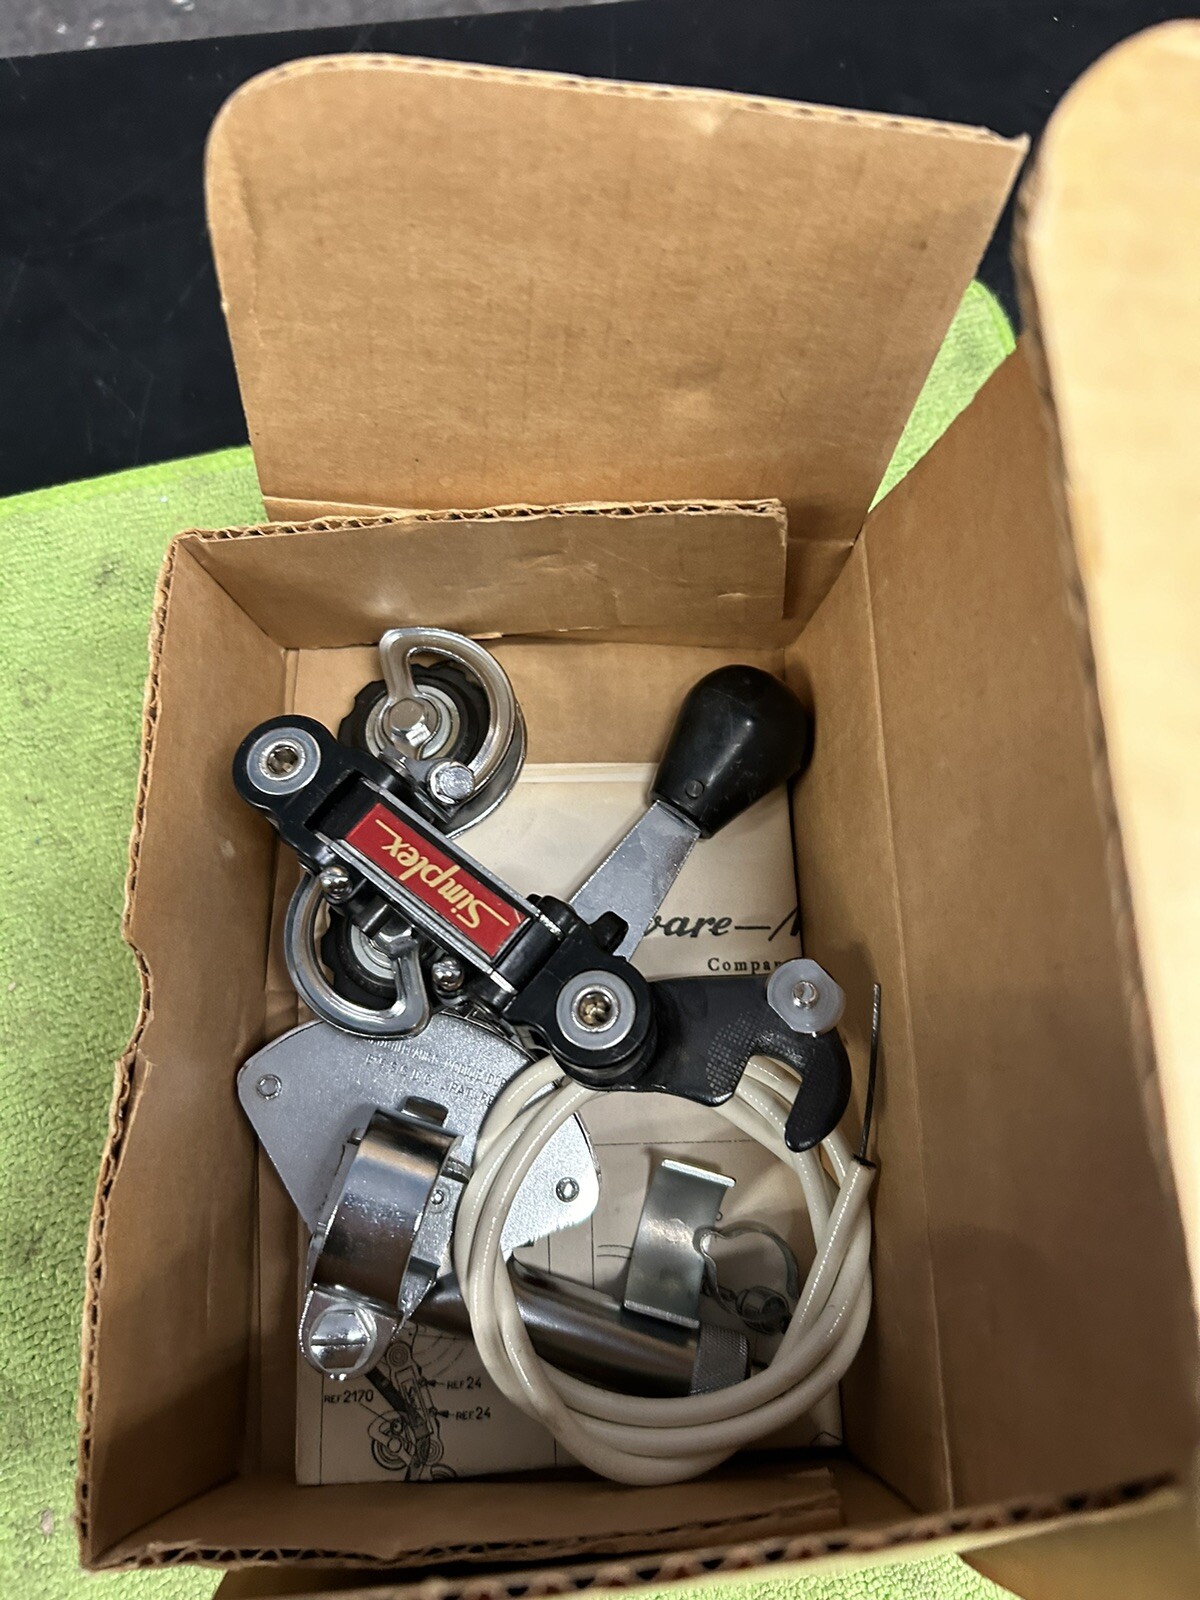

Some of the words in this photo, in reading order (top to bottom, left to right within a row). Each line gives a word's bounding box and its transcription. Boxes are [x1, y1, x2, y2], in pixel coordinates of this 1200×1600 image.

[375, 819, 510, 929] Simplex
[466, 1376, 482, 1390] 24
[343, 1388, 374, 1403] 2170
[476, 1406, 491, 1420] 24
